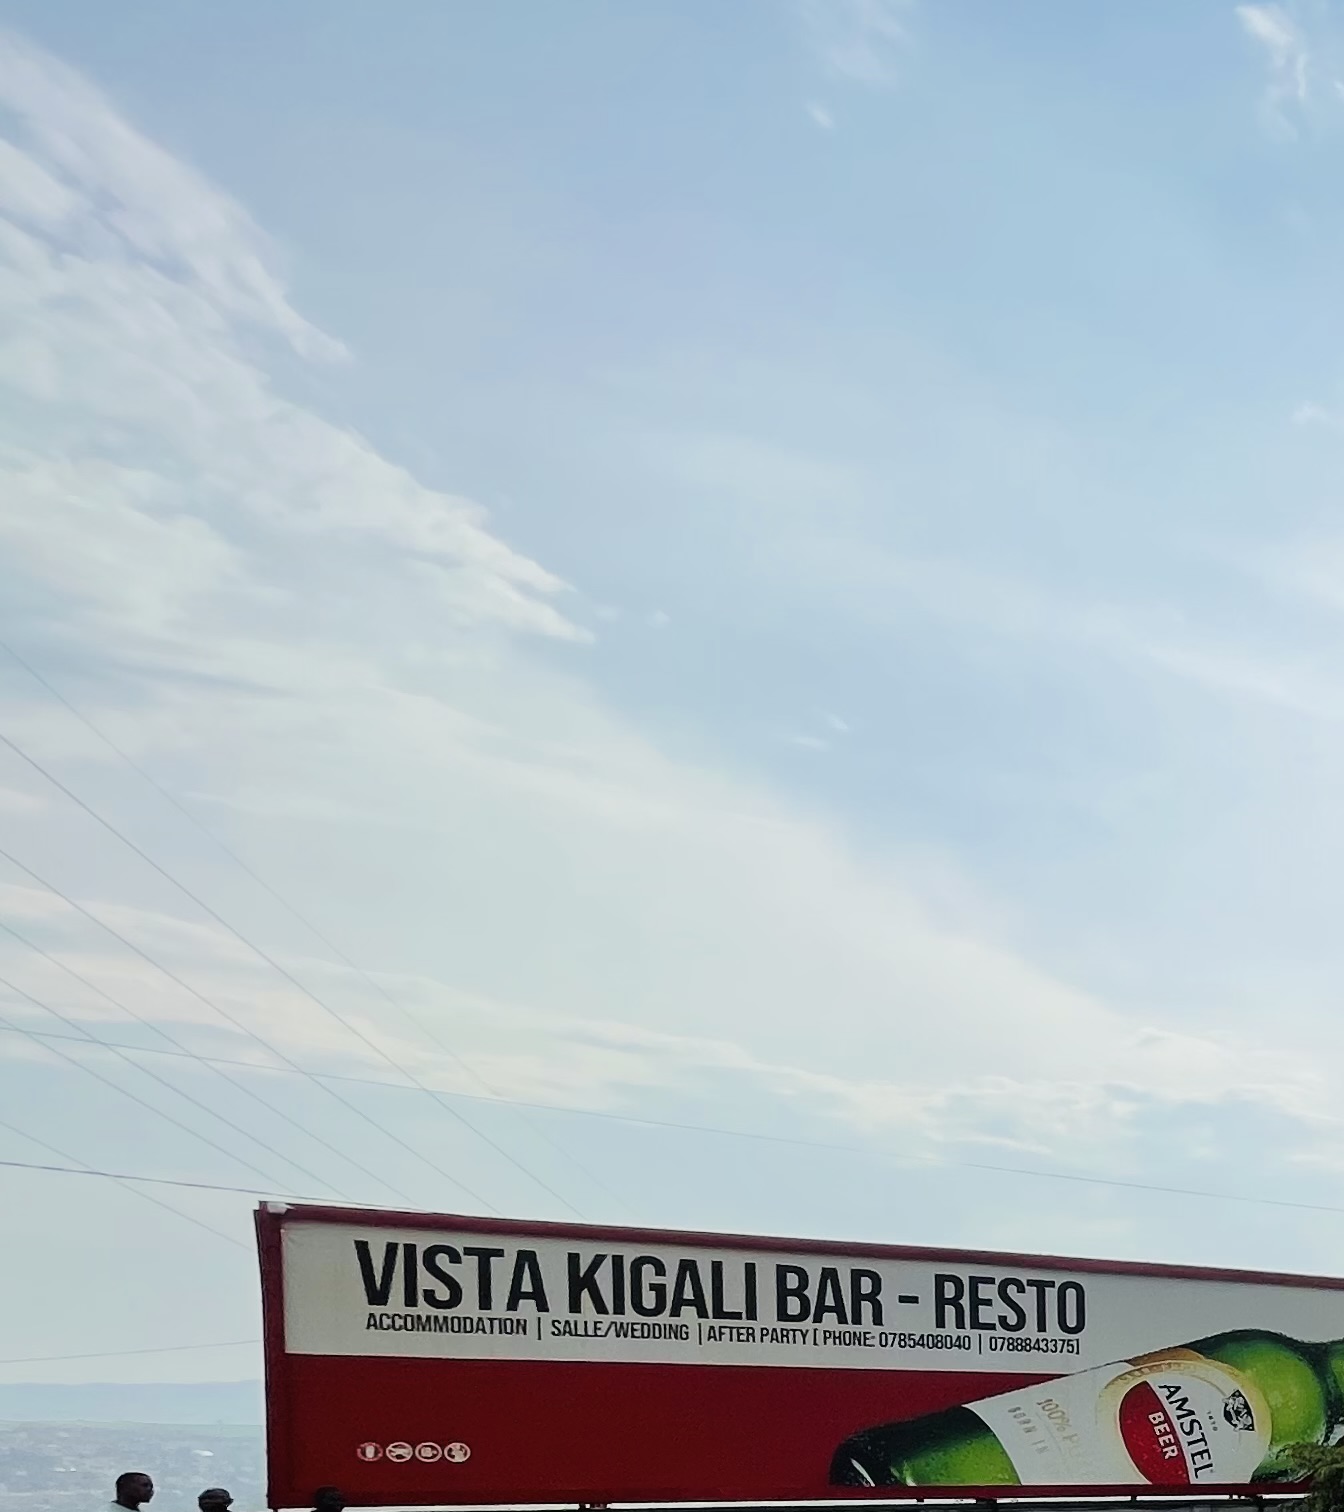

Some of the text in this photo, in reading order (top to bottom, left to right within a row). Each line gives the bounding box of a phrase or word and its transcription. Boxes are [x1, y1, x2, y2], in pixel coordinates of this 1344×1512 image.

[354, 1239, 1087, 1335] VISTA KIGALI BAR - RESTO
[366, 1313, 528, 1336] ACCOMMODATION
[551, 1319, 690, 1341] SALLE/WEDDING
[707, 1325, 756, 1343] AFTER
[760, 1327, 809, 1346] PARTY
[878, 1331, 971, 1351] 0785408040
[1036, 1398, 1072, 1432] 100%
[1148, 1411, 1179, 1460] BEER
[1158, 1385, 1213, 1479] AMSTEL
